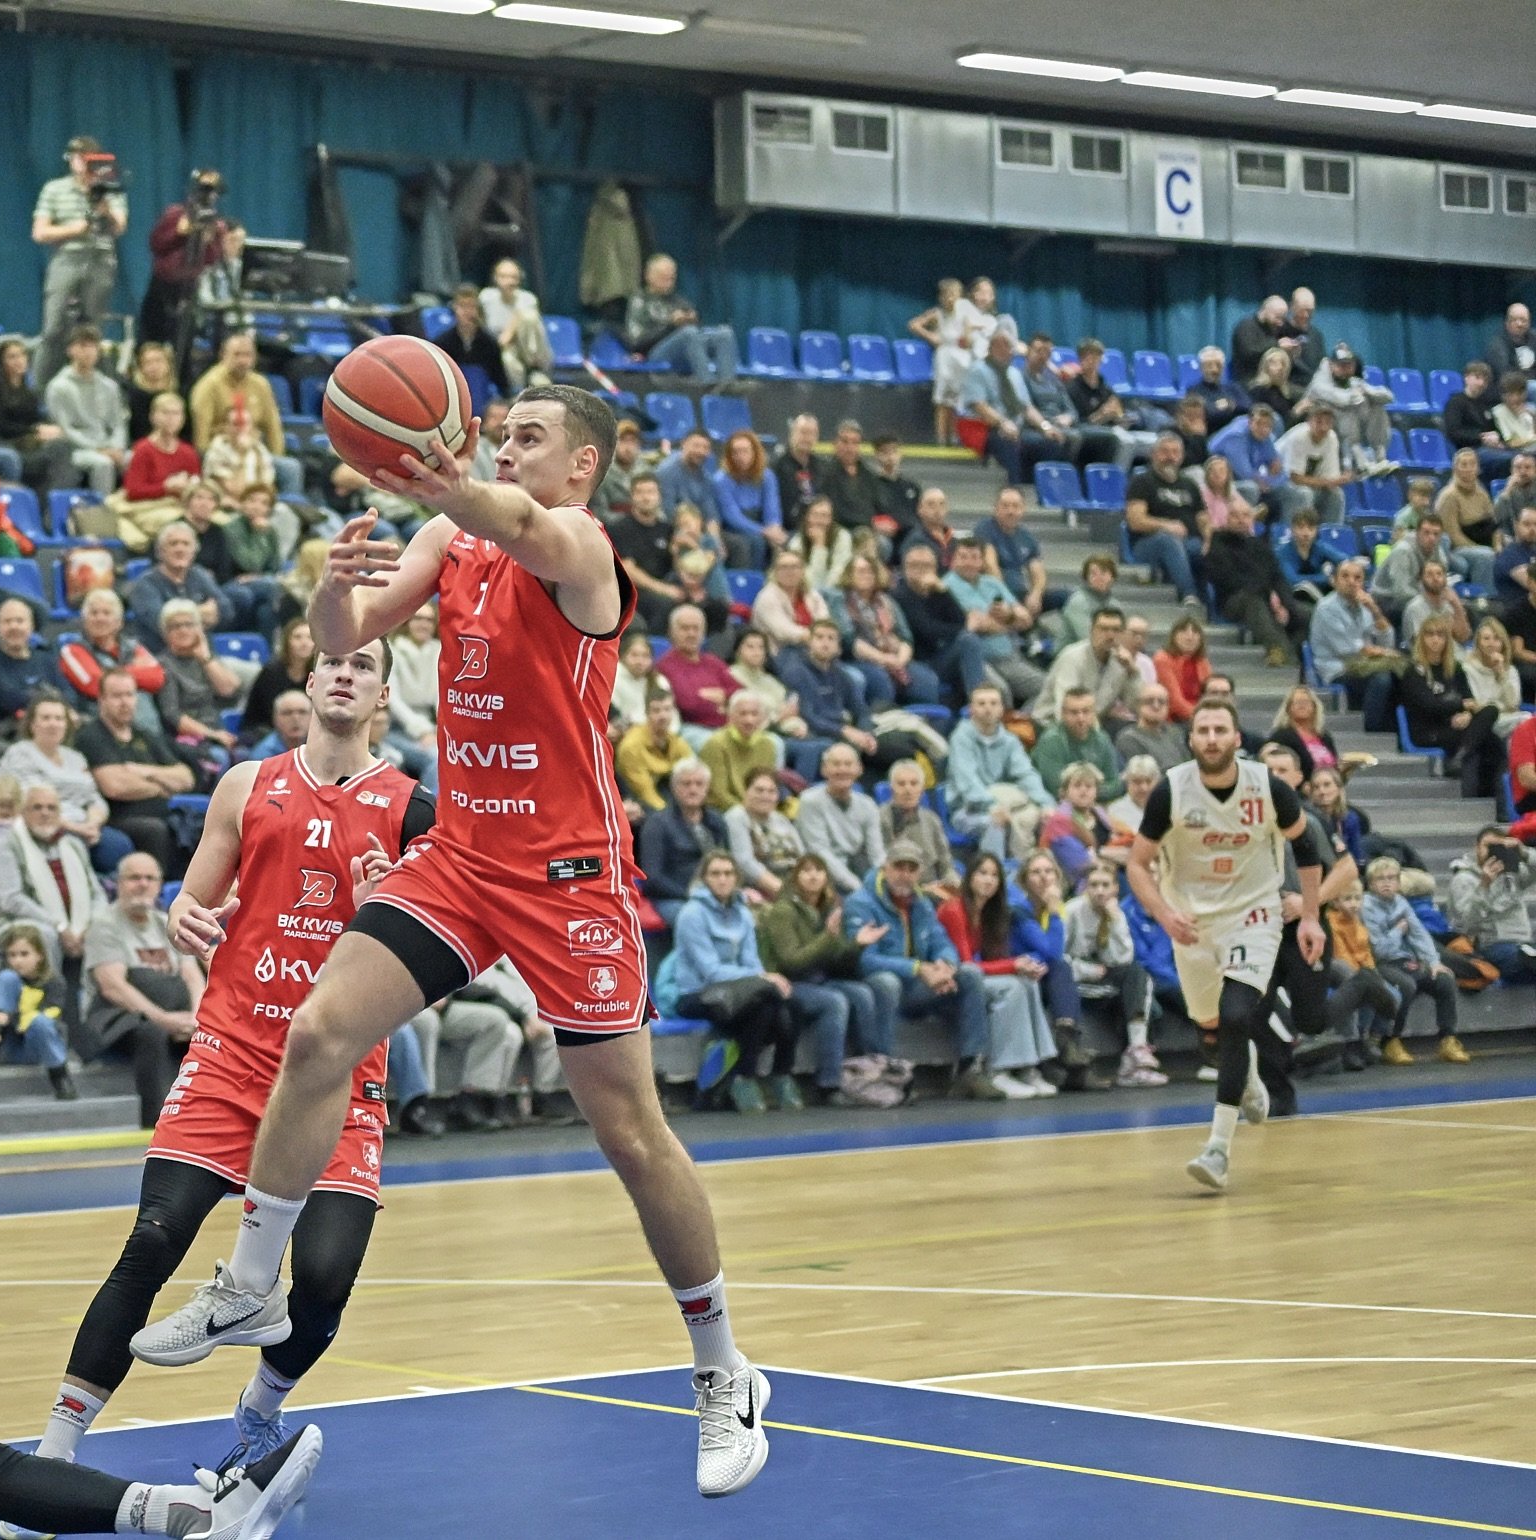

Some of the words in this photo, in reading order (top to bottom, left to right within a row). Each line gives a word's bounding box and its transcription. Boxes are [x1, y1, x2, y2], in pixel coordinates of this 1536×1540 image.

[1166, 169, 1191, 215] C
[472, 582, 489, 615] 7
[465, 693, 504, 711] KVIS
[452, 706, 493, 721] PARDUBICE
[457, 742, 539, 771] KVIS
[1240, 799, 1264, 826] 31
[304, 818, 332, 849] 21
[583, 860, 590, 870] L
[277, 913, 303, 929] BK
[303, 917, 344, 934] KVIS
[283, 929, 331, 942] PARDUBICE
[579, 927, 614, 944] HAK
[574, 1001, 630, 1013] Pardubice
